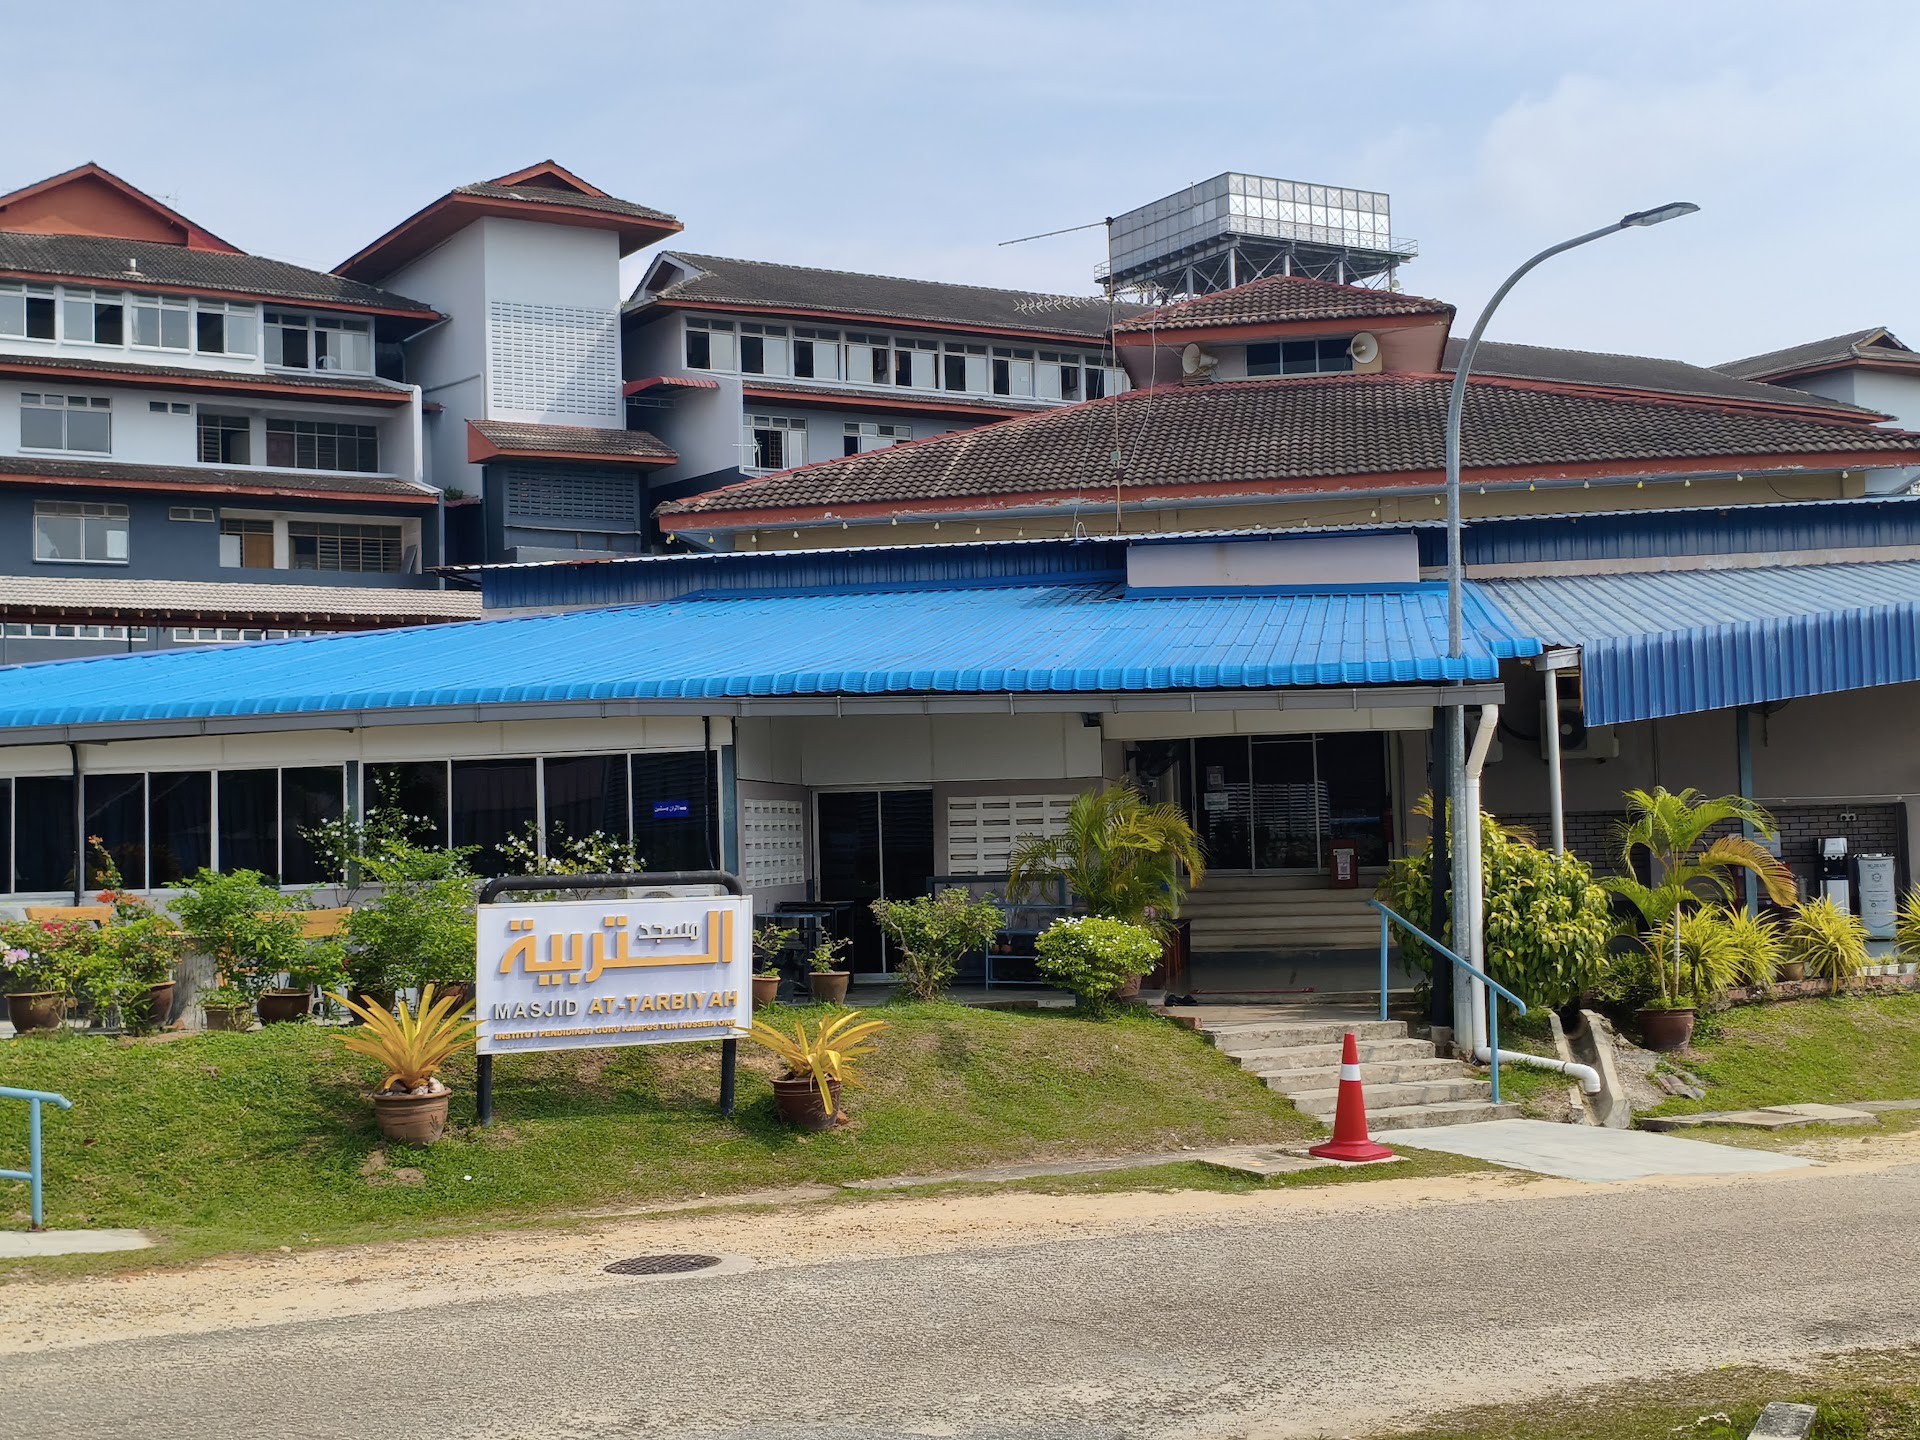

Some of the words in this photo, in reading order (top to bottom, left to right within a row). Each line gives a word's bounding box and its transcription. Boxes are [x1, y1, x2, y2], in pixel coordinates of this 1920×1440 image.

[638, 922, 700, 944] مسجد
[500, 910, 734, 986] التربية
[494, 1000, 579, 1020] MASJID
[588, 990, 738, 1015] AT-TARBIYAH
[494, 1031, 537, 1041] INSTITUT
[539, 1027, 593, 1038] PENDIDIKAN
[595, 1025, 621, 1035] GURU
[622, 1022, 659, 1033] KAMPUS
[660, 1021, 679, 1030] TUN
[680, 1019, 717, 1030] HUSSEIN
